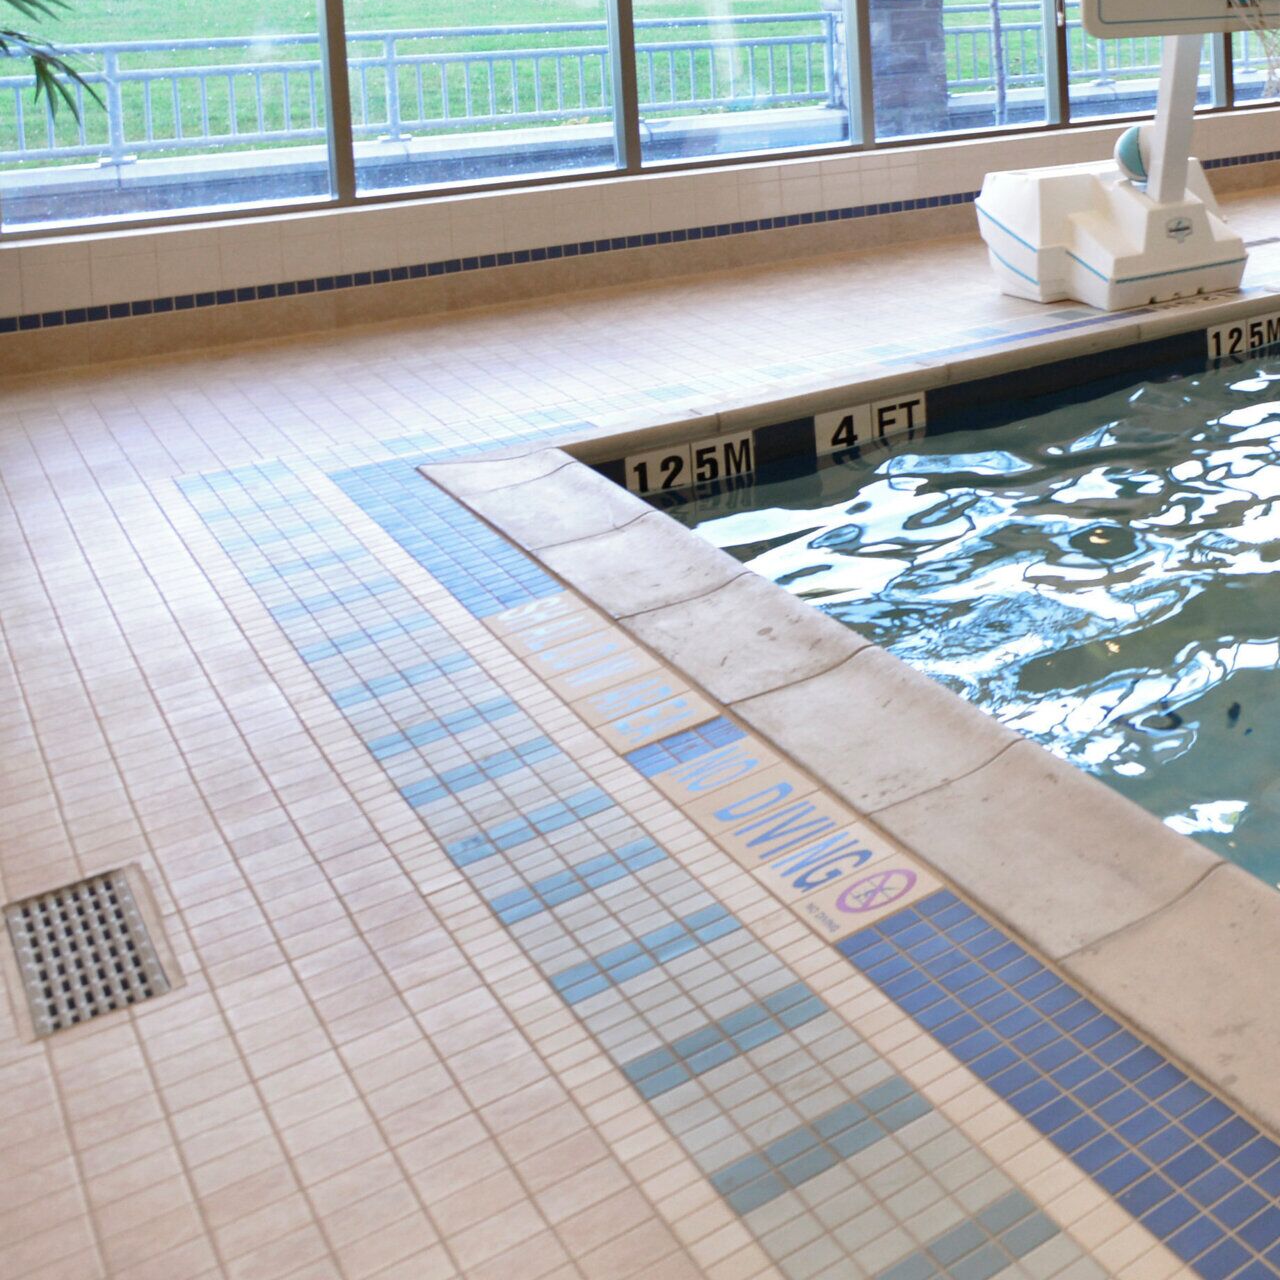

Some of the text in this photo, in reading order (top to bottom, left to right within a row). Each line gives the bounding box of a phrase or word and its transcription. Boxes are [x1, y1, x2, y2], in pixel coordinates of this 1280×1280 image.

[831, 415, 858, 447] 4
[877, 399, 921, 440] FT
[586, 676, 697, 744] AREA
[669, 744, 873, 893] NO DIVING
